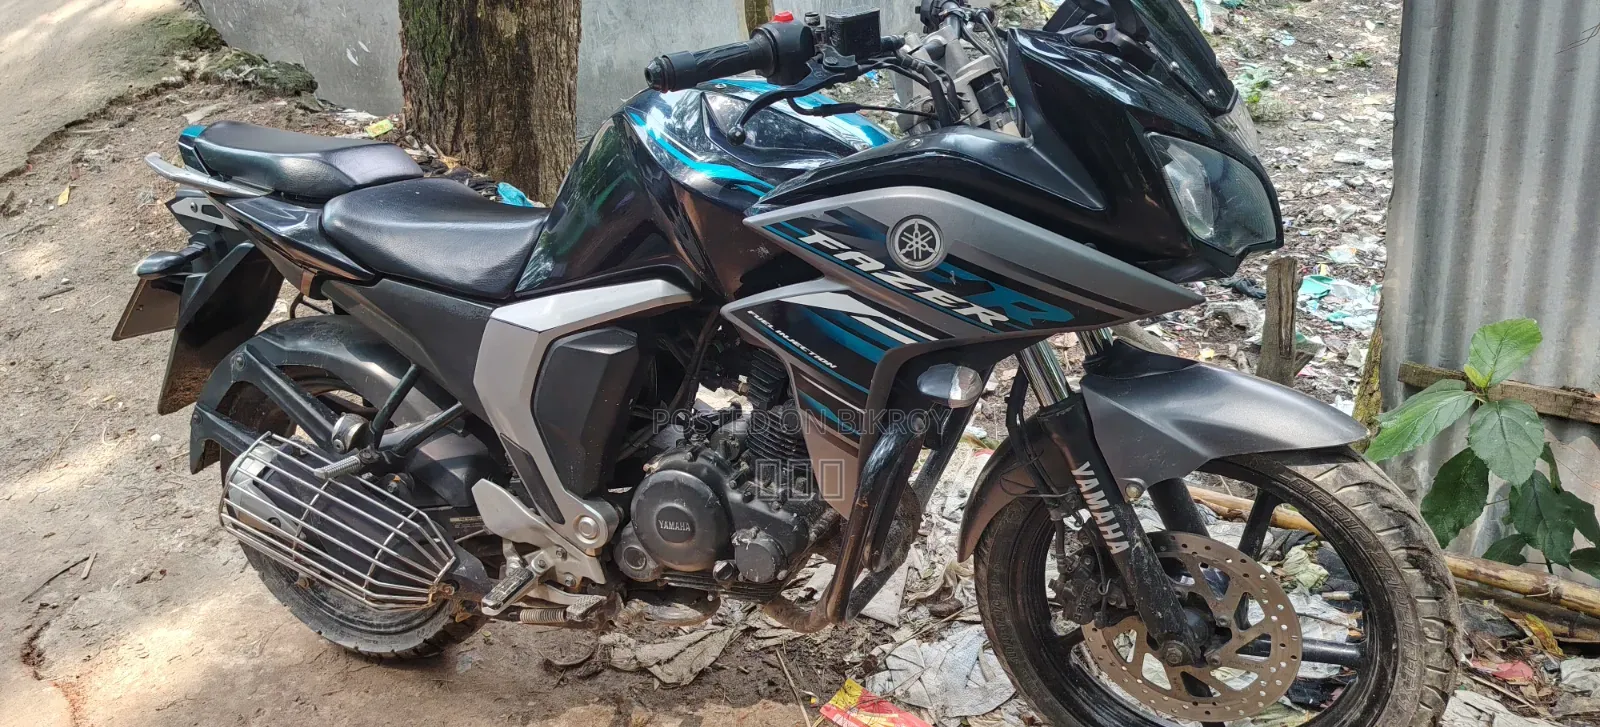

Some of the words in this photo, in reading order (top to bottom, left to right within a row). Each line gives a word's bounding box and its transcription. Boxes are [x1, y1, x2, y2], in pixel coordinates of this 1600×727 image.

[798, 228, 1009, 326] FAZER
[747, 310, 775, 331] FUEL
[775, 329, 837, 369] INJECTION
[658, 520, 691, 532] YAMAHA
[1071, 461, 1130, 554] YAMAHA
